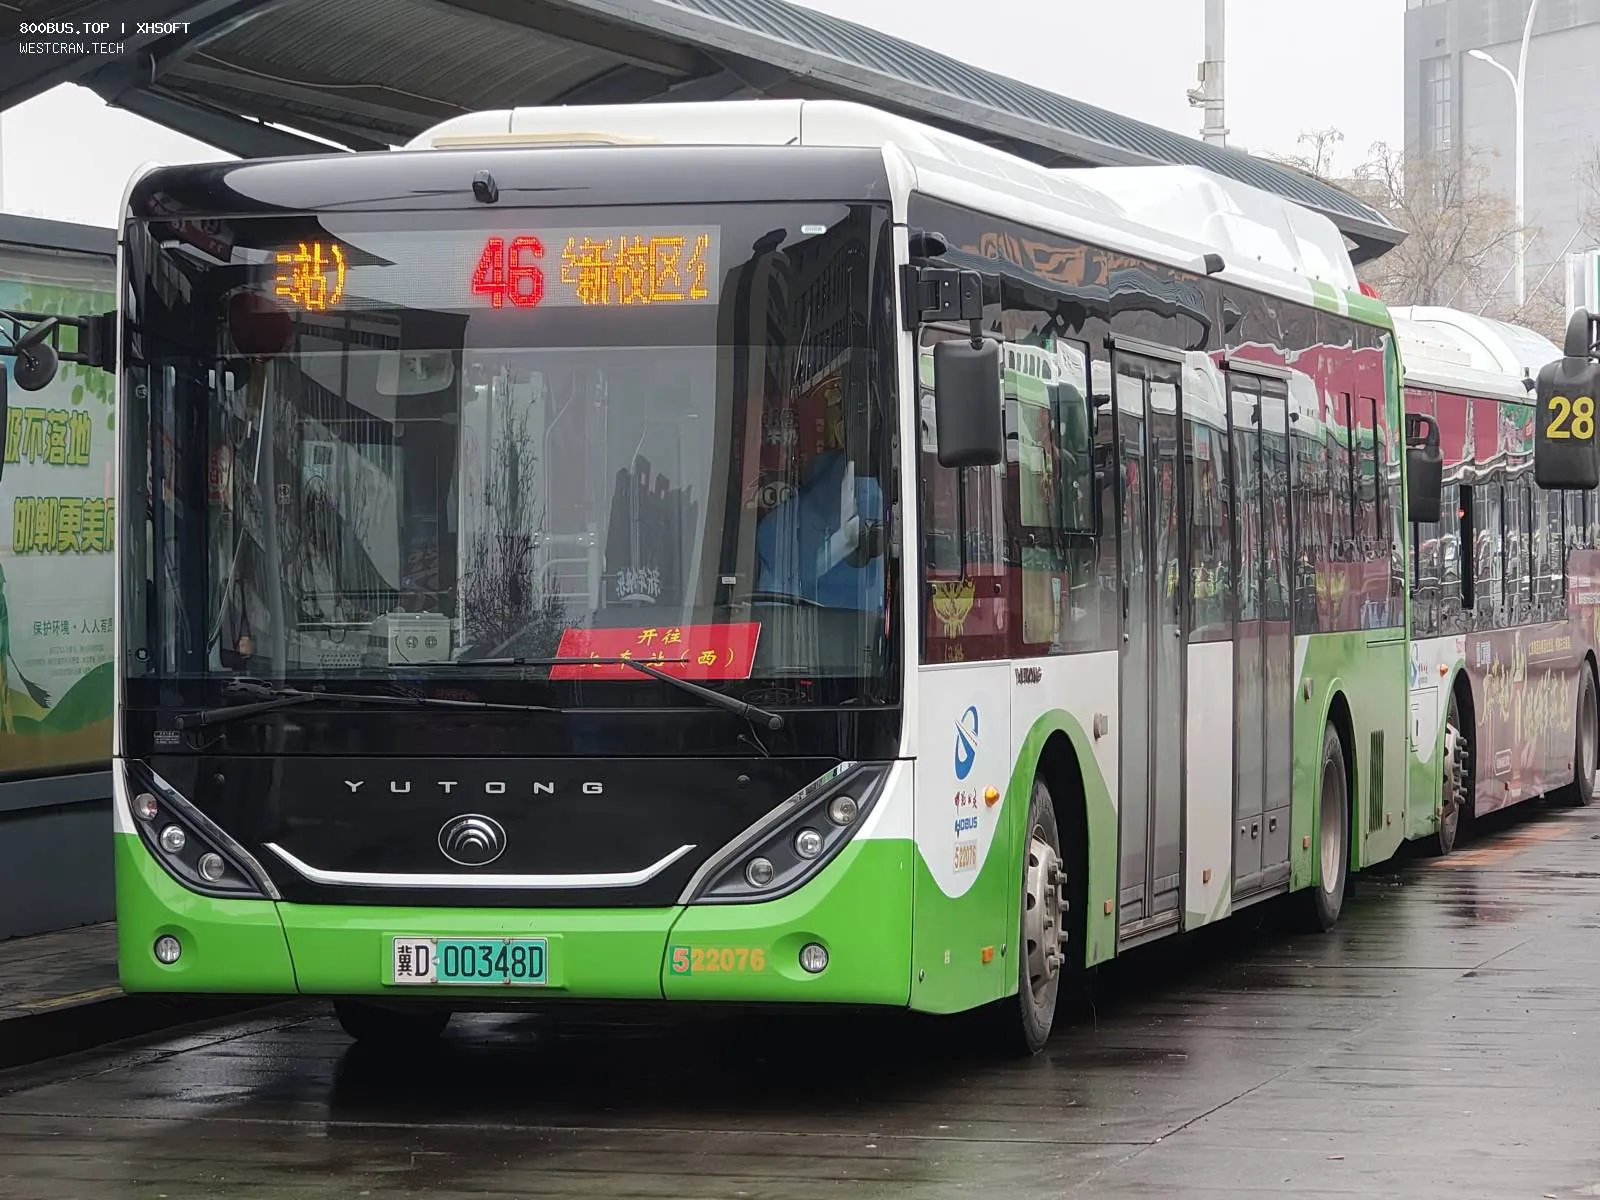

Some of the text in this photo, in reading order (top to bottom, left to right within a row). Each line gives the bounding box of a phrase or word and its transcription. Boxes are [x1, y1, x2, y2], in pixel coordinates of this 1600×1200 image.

[472, 236, 544, 308] 46
[1546, 396, 1595, 440] 28
[637, 628, 682, 646] 开往
[344, 780, 603, 794] YUTONG
[671, 947, 765, 973] 522076
